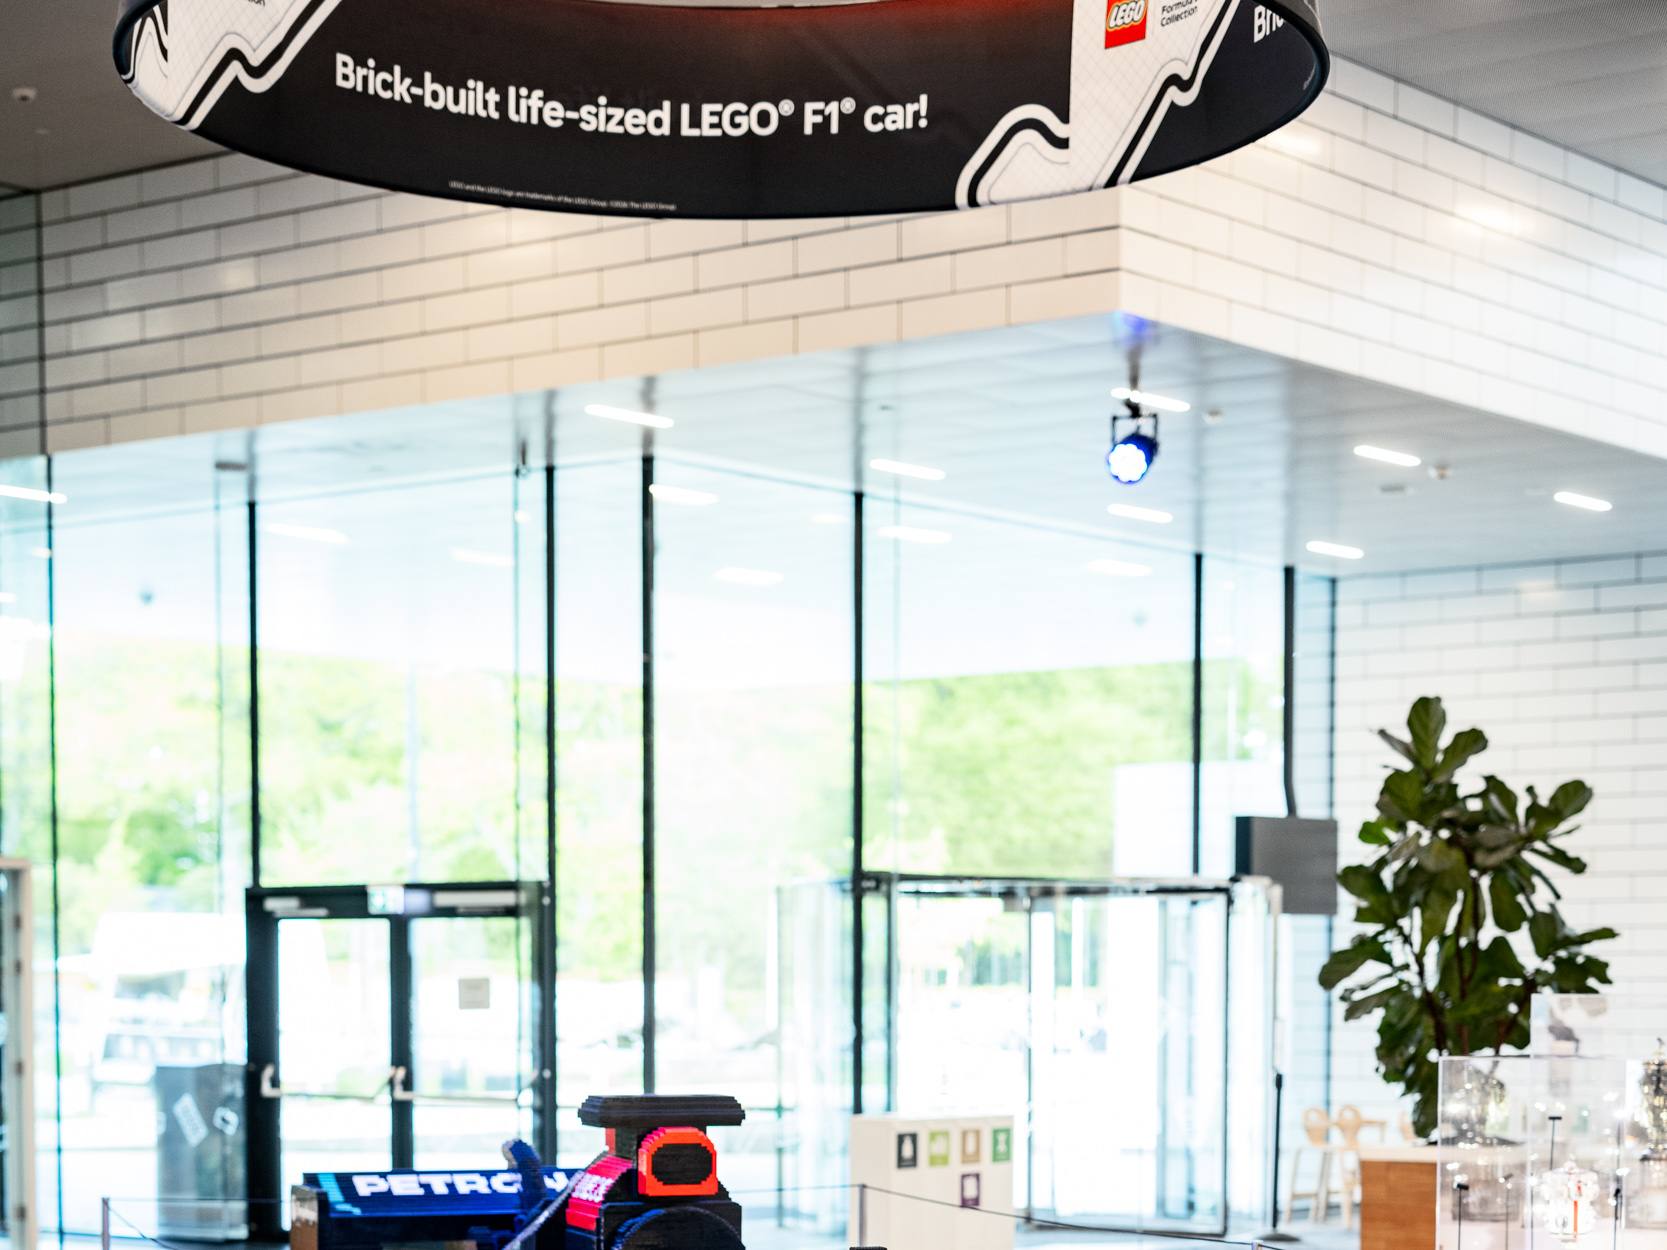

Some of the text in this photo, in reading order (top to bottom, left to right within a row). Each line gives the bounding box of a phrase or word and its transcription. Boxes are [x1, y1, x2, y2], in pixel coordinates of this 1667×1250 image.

[1108, 0, 1146, 29] LEGO
[1160, 6, 1198, 27] Collection
[335, 52, 500, 120] Brick-built
[507, 85, 671, 136] life-sized
[863, 94, 928, 133] car!
